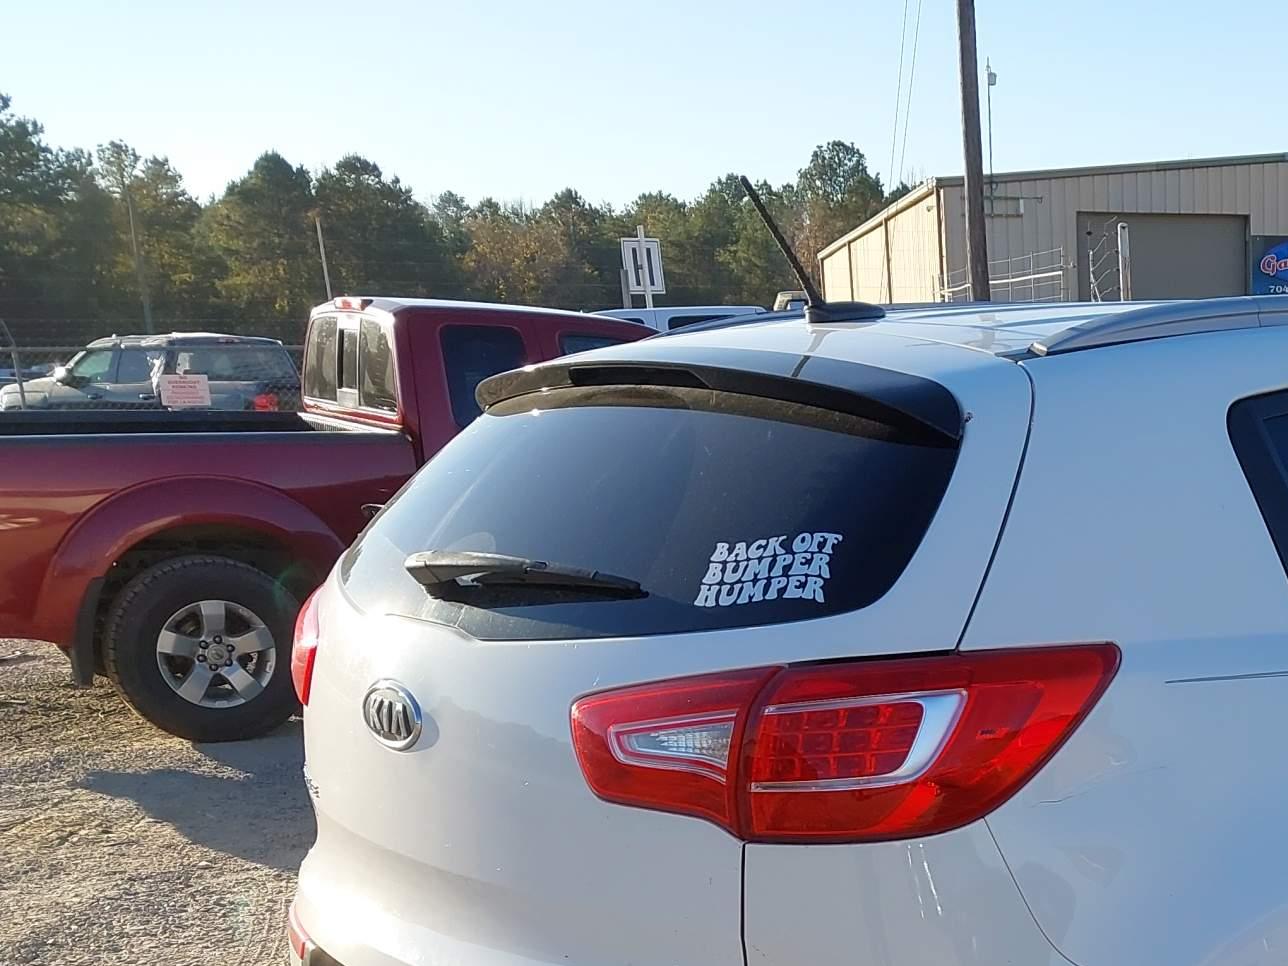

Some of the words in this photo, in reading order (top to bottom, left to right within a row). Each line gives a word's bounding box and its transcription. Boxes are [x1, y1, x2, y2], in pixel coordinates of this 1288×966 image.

[710, 535, 788, 562] BACK
[792, 532, 843, 554] OFF
[702, 552, 832, 585] BUMPER
[693, 575, 825, 608] HUMPER
[368, 695, 411, 739] KIA
